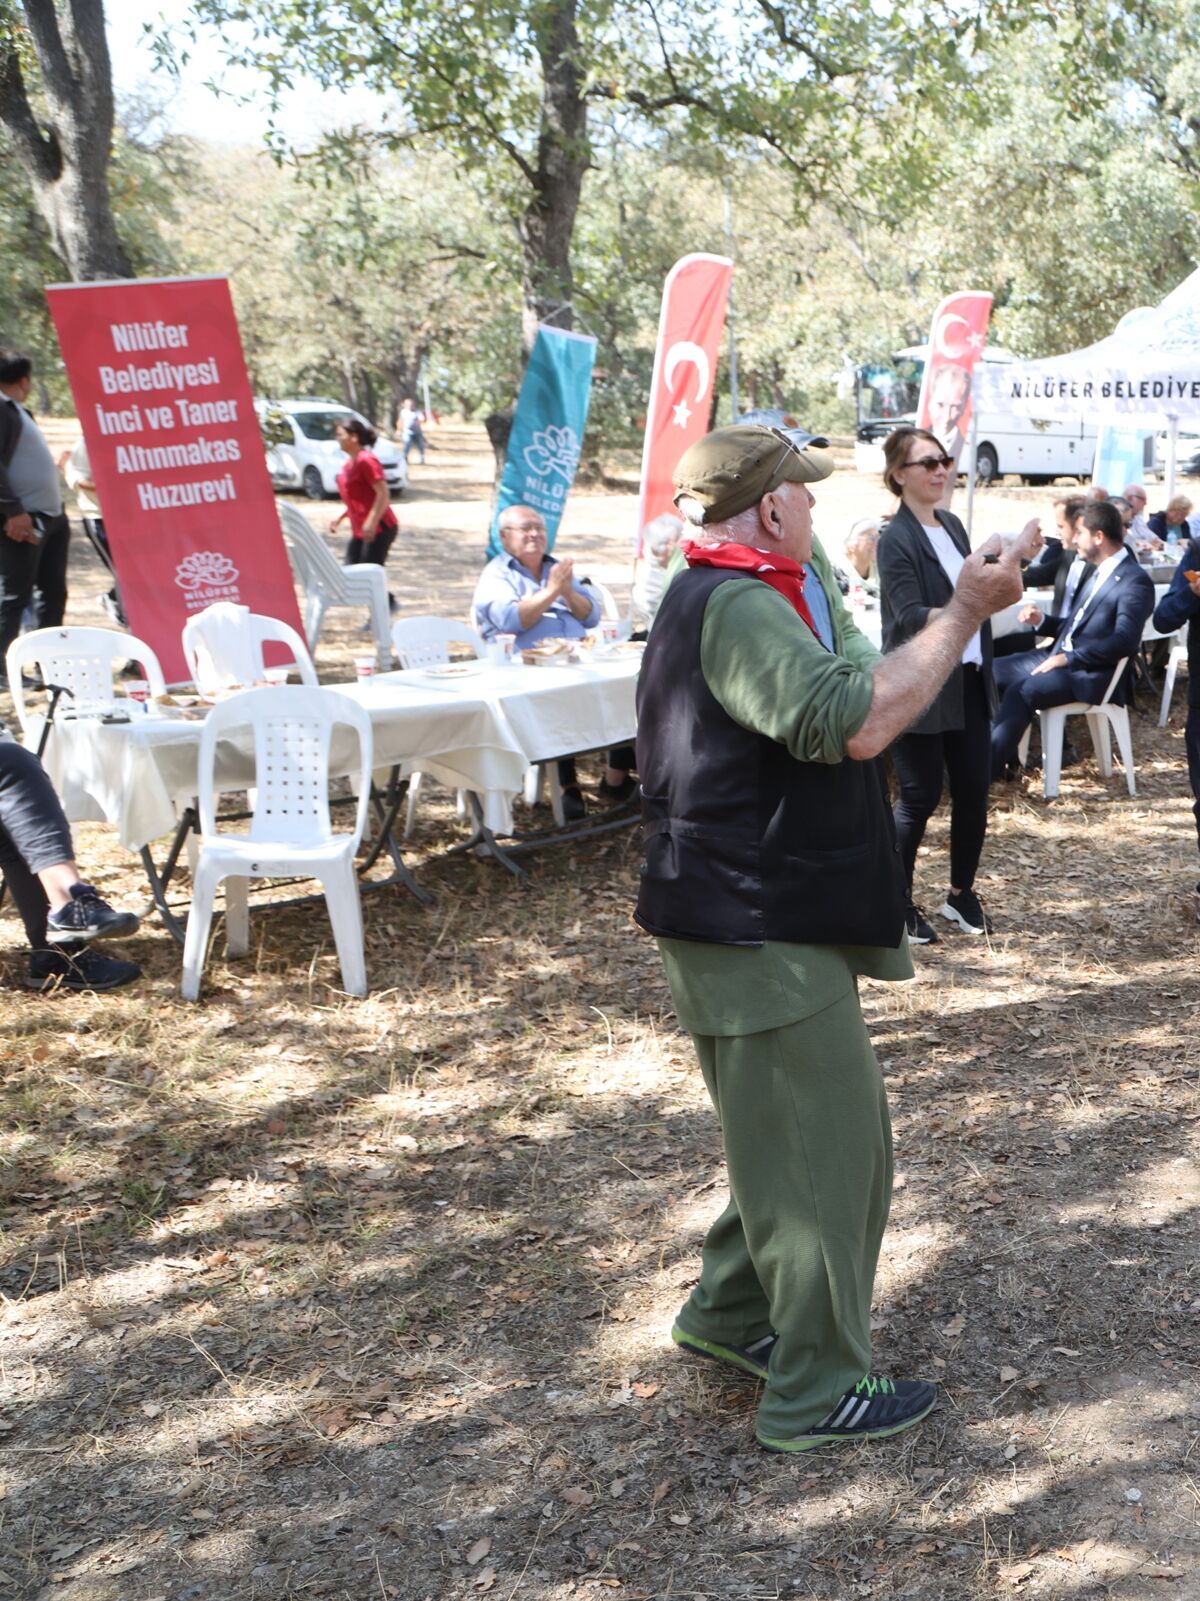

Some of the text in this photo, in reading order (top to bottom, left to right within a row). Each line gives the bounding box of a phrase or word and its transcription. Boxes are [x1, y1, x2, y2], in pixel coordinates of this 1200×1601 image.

[110, 321, 188, 352] Nilüfer
[99, 357, 220, 395] Belediyesi
[1011, 377, 1093, 398] NİLÜFER
[96, 398, 239, 436] İnci ve Taner
[115, 437, 241, 474] Altınmakas
[137, 473, 236, 511] Huzurevi
